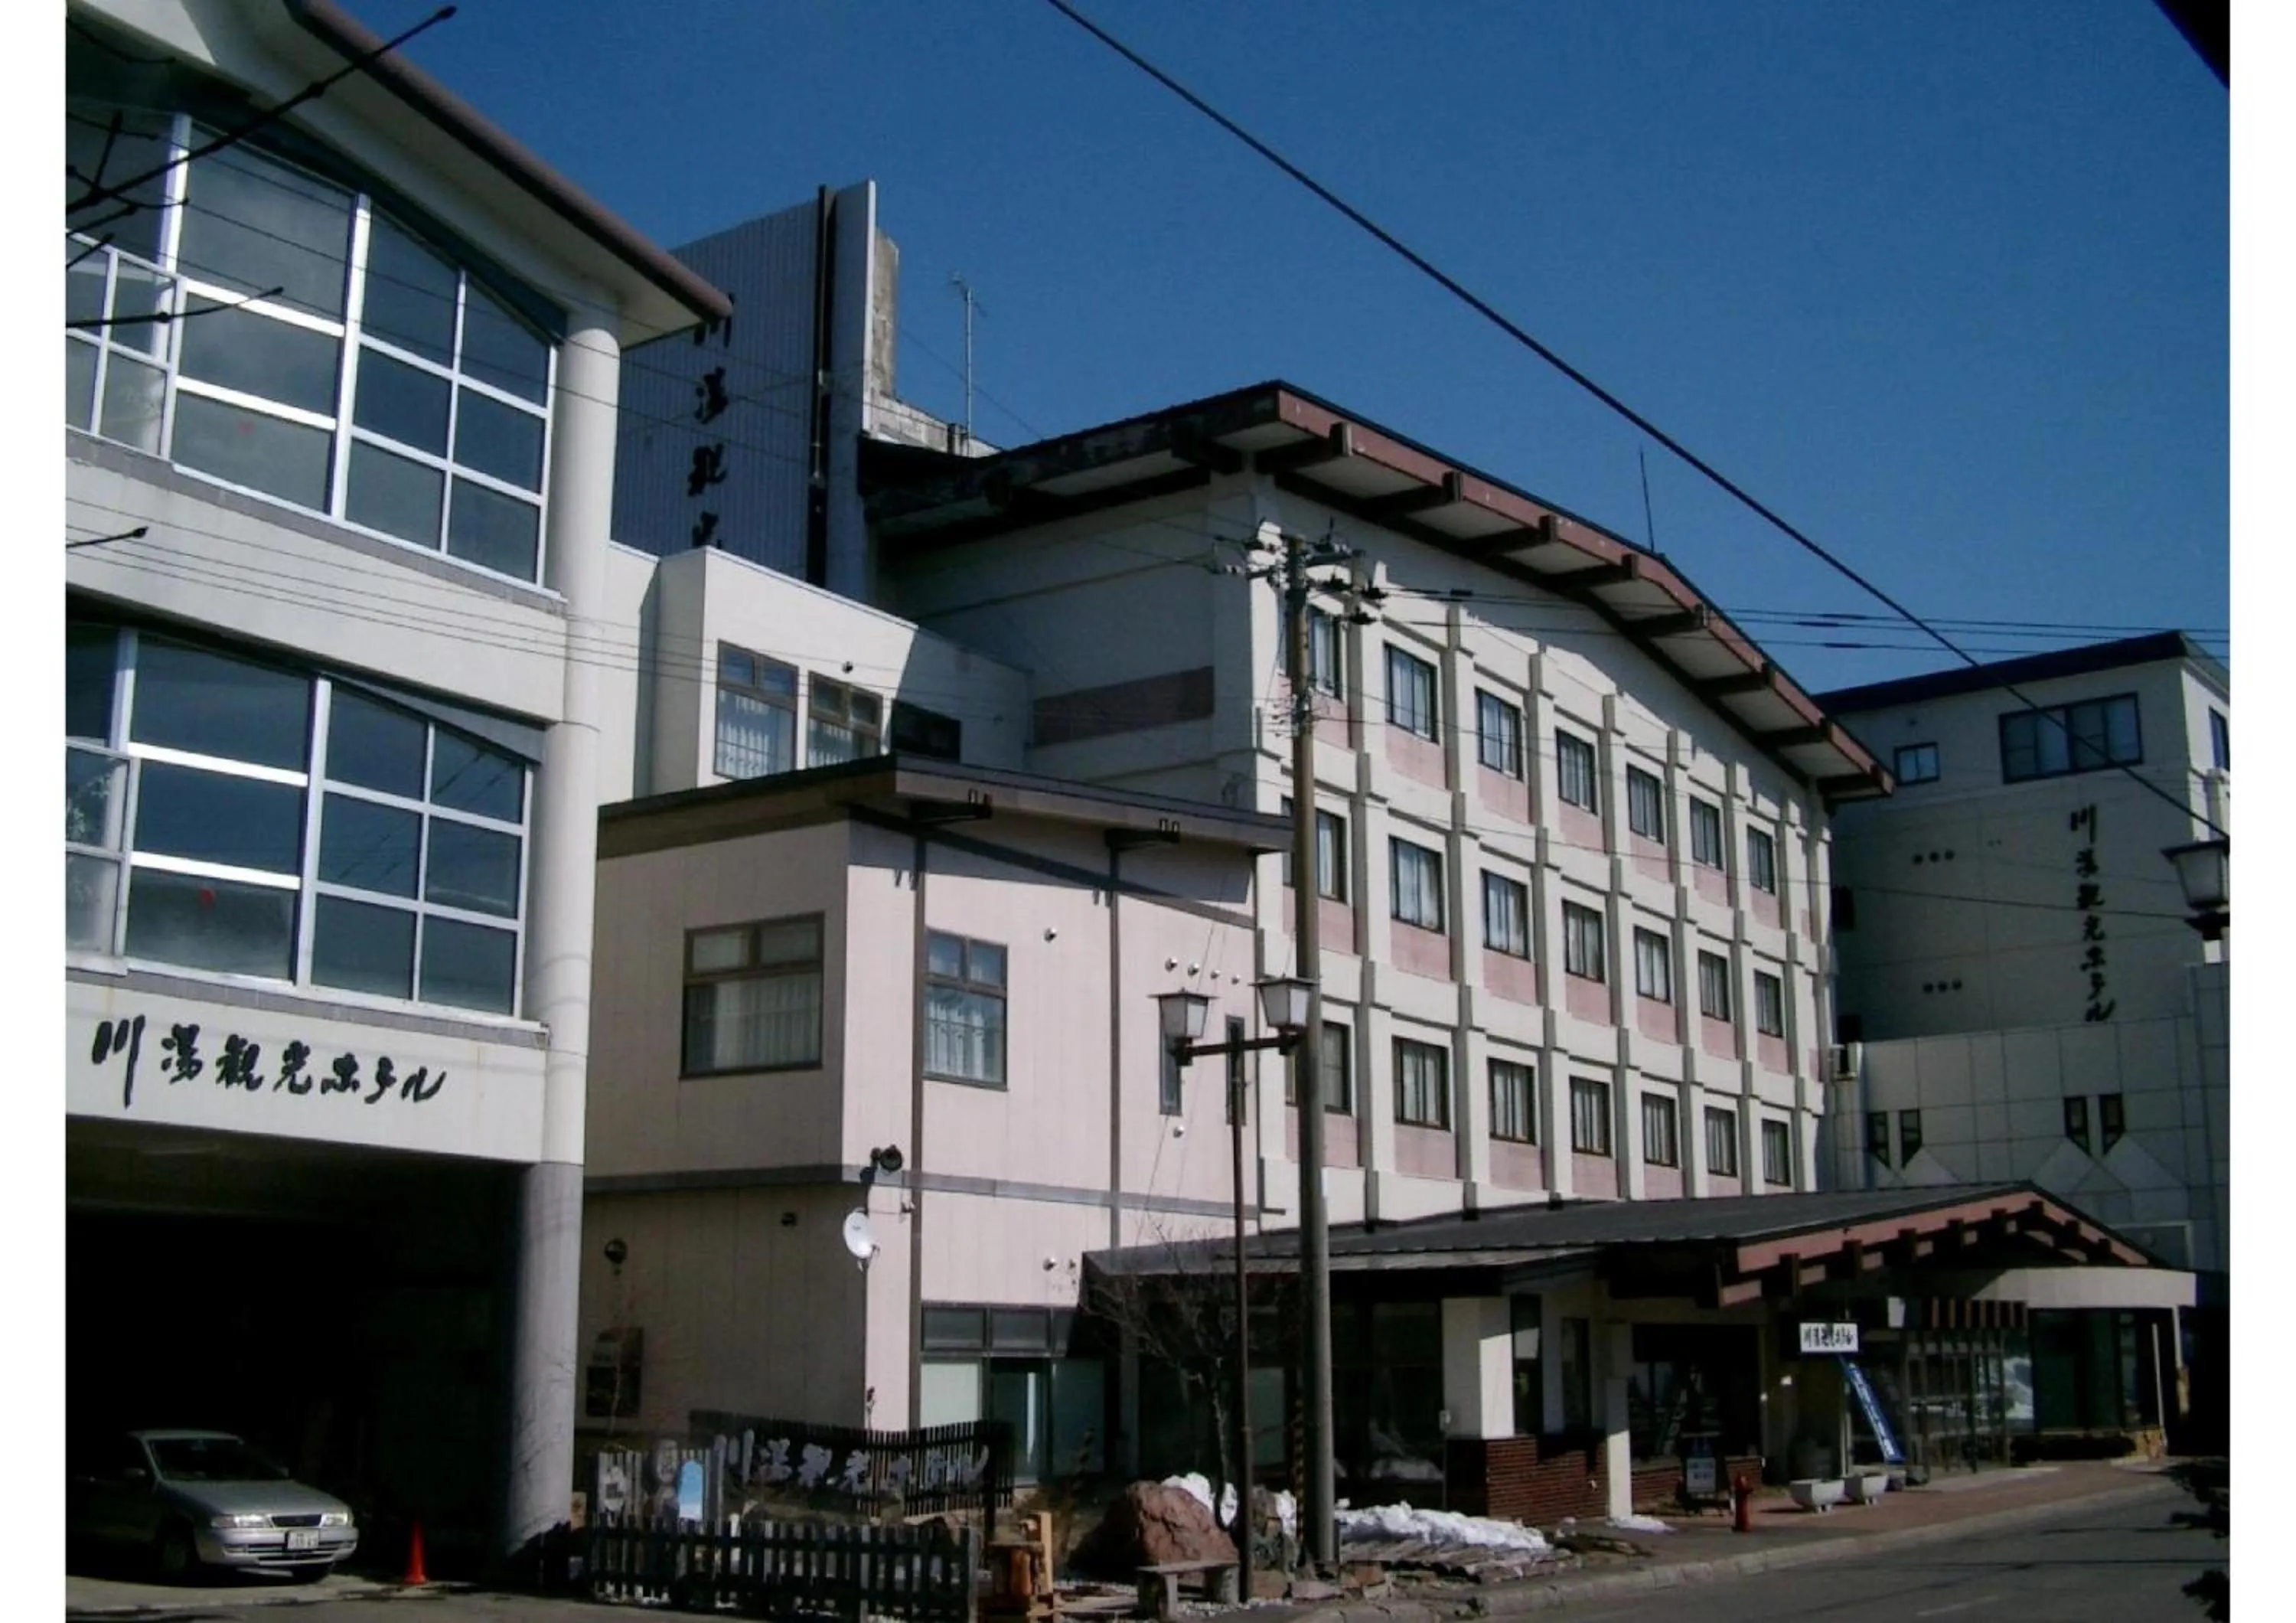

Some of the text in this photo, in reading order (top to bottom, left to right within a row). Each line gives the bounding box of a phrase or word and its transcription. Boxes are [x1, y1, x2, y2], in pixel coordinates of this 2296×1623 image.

[2069, 804, 2116, 1021] 川湯観光ホテル
[91, 1014, 445, 1109] 川湯観光ホテル
